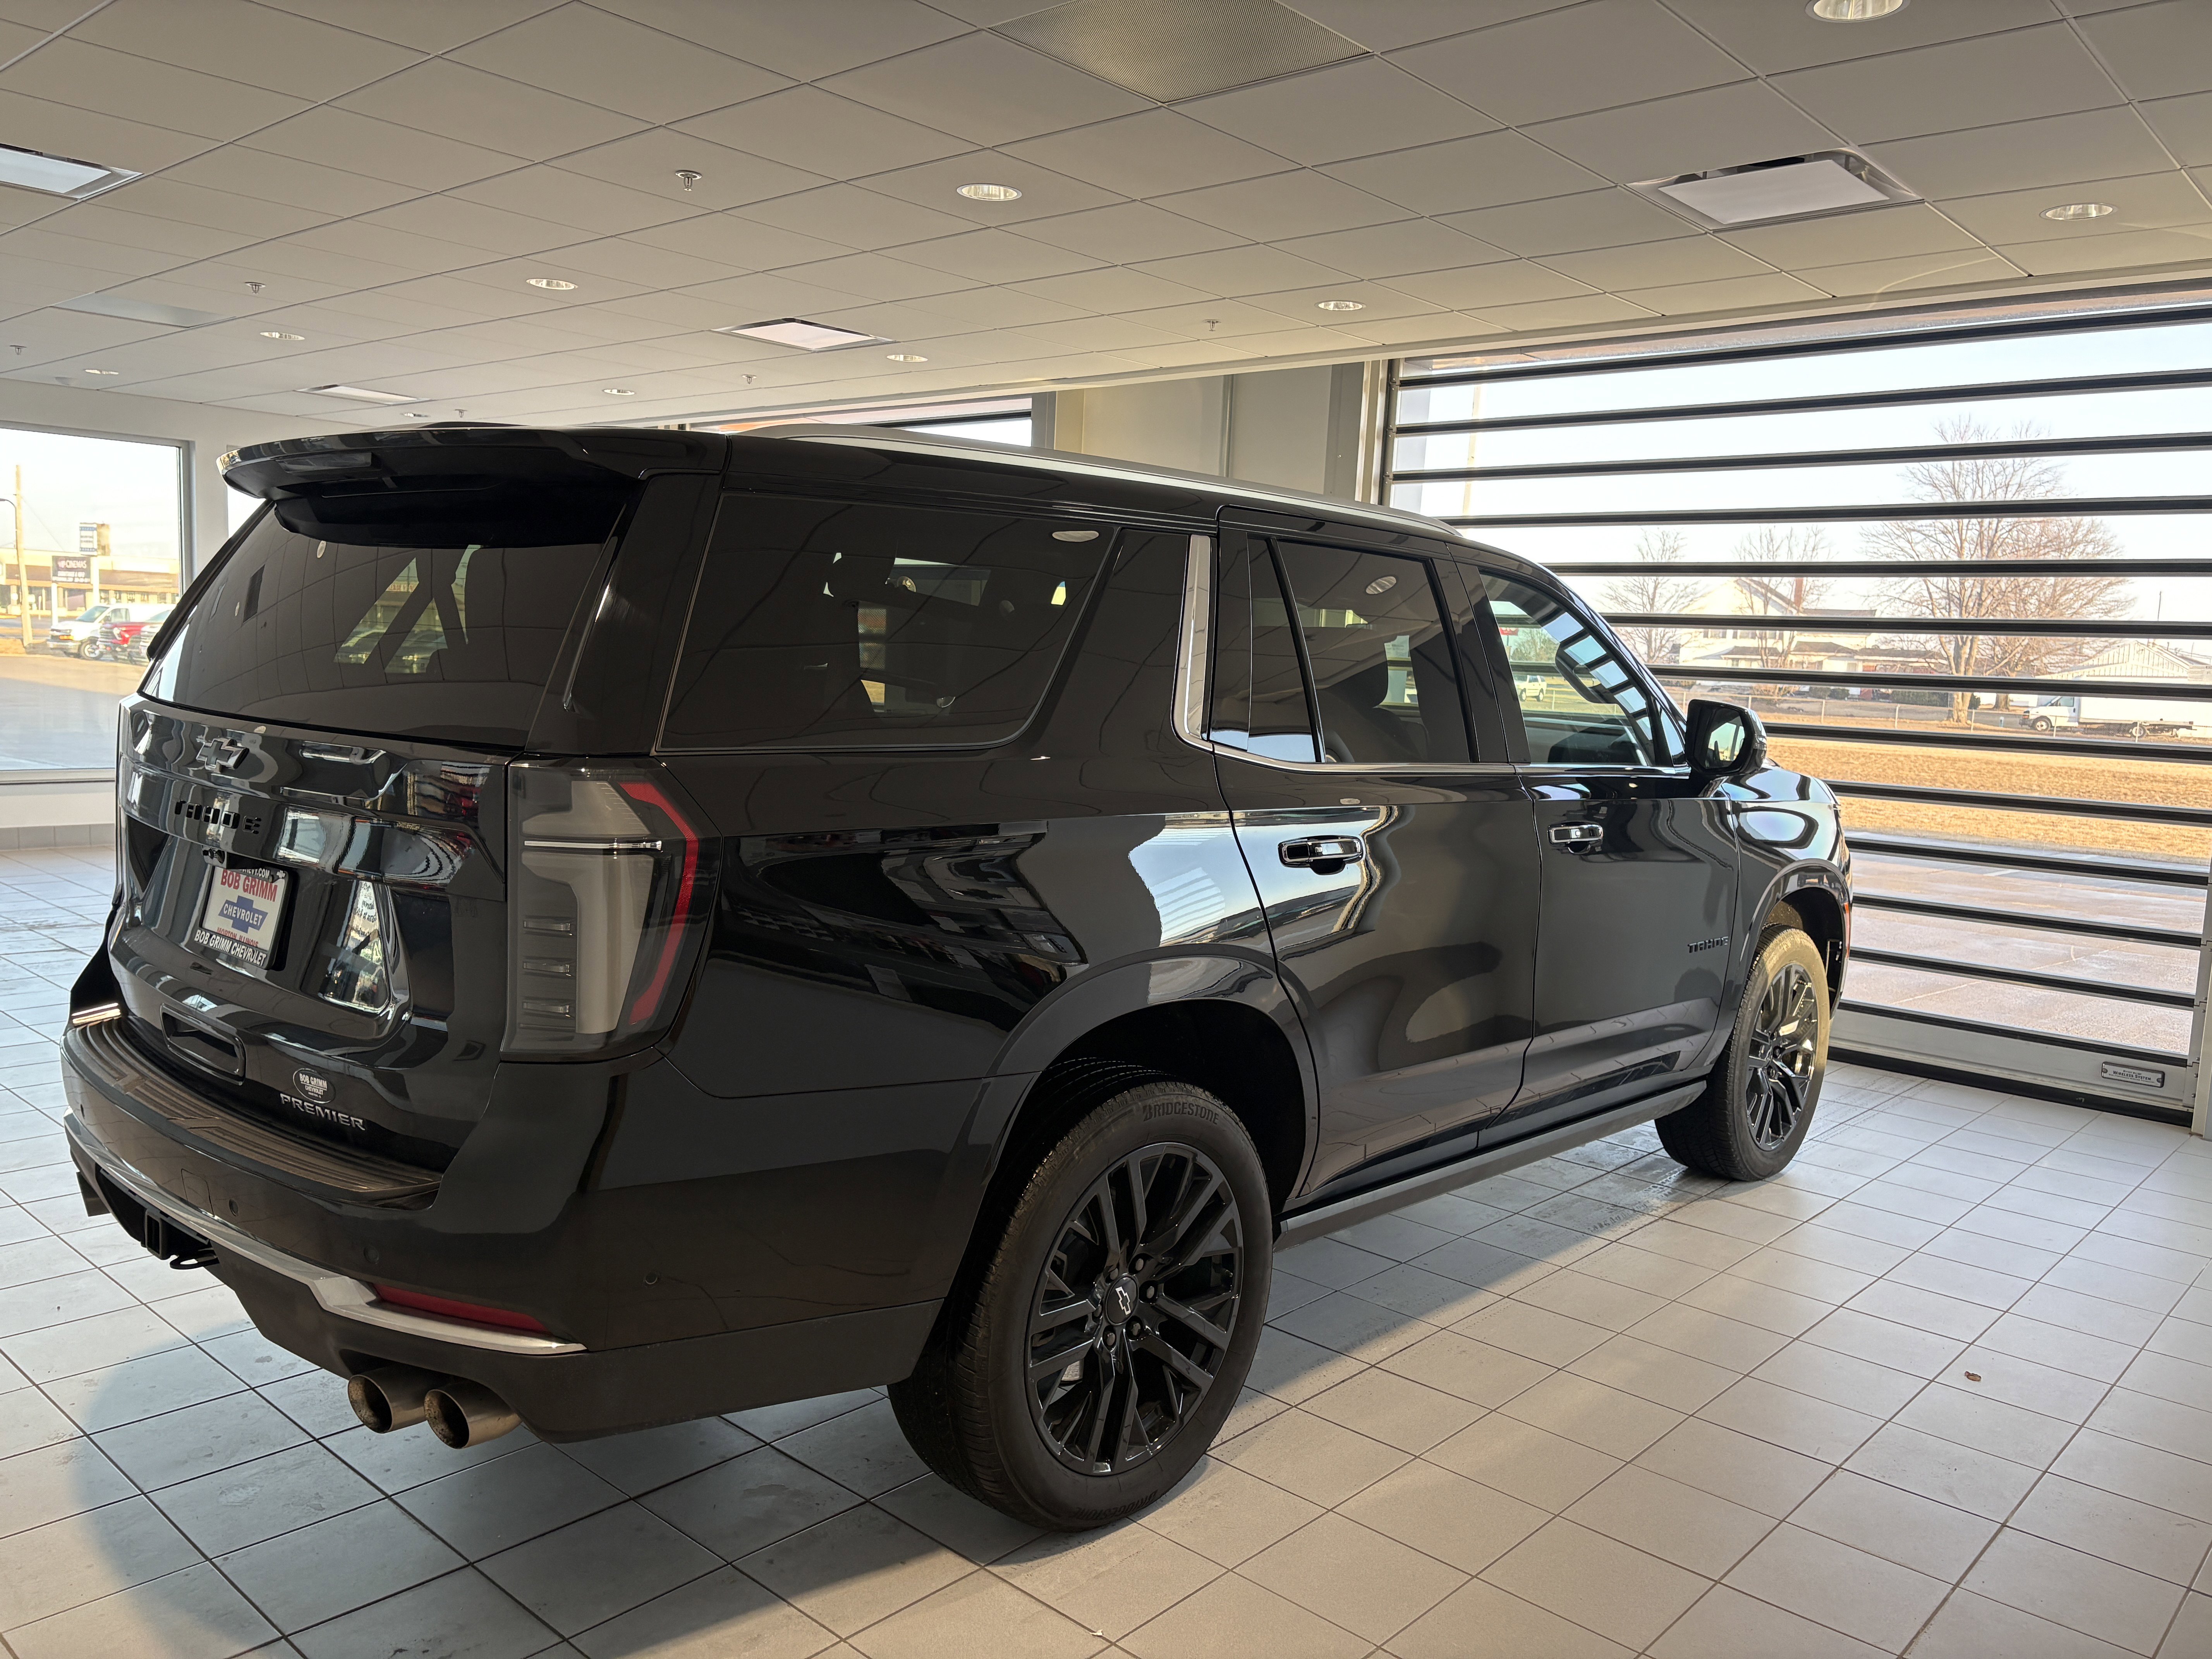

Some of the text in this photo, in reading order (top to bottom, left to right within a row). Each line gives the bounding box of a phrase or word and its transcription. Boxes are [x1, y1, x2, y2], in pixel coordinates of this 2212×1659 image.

[174, 800, 262, 835] TAHOE
[220, 868, 278, 902] BOB GRIMM
[223, 903, 263, 926] CHEVROLET
[194, 929, 267, 966] BOB GRIMM CHEVROLET
[1687, 936, 1729, 953] TAHOE
[299, 1073, 327, 1089] BOB GRIMM
[280, 1093, 366, 1131] PREMIER
[1143, 1102, 1220, 1125] BRIDGESTONE
